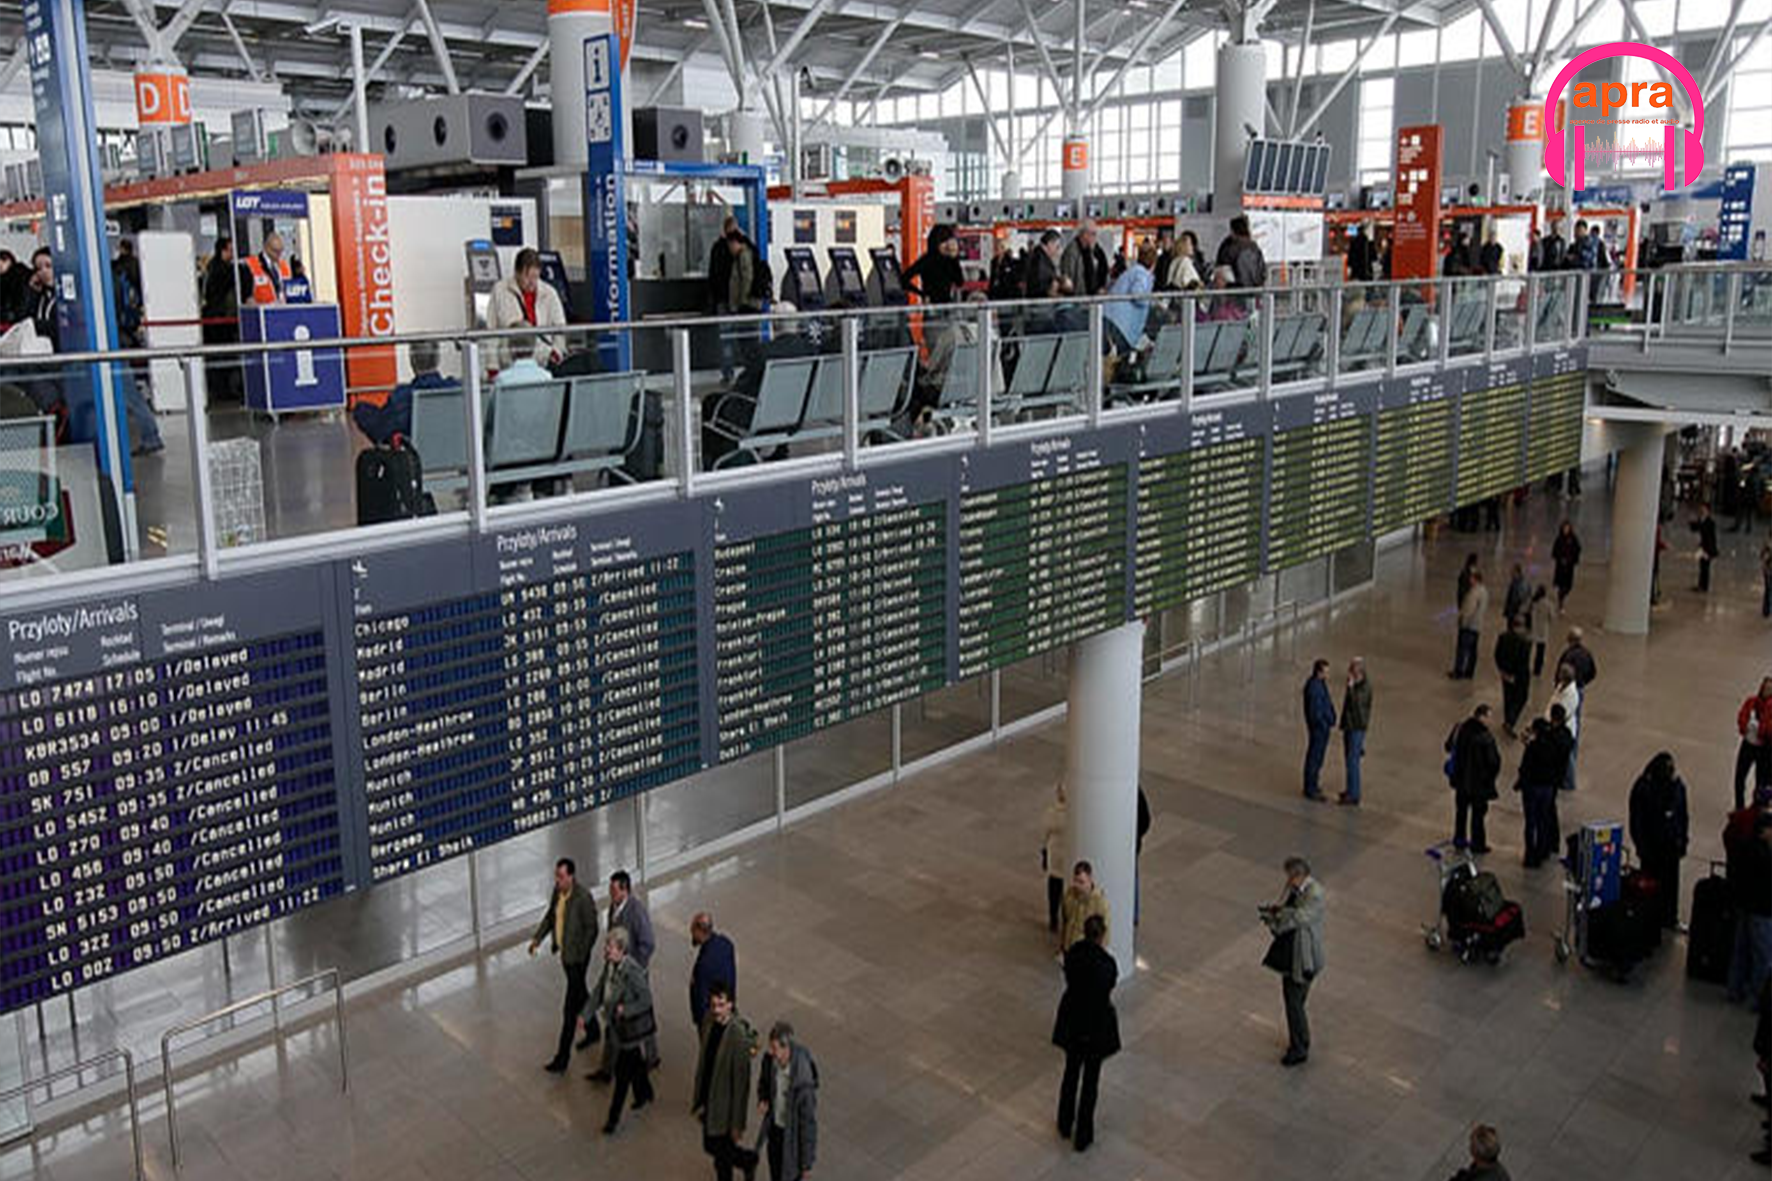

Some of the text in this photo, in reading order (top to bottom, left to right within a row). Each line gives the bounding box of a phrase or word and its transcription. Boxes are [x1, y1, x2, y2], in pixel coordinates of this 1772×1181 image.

[140, 82, 160, 115] D
[1524, 110, 1539, 135] E
[363, 175, 393, 336] Check-in
[9, 601, 138, 642] Przyloty/Arrivals
[20, 690, 40, 708] LO
[22, 717, 44, 735] LO
[34, 820, 56, 839] LO
[37, 846, 58, 864] LO
[40, 872, 60, 890] LO
[43, 897, 64, 915] LO
[48, 946, 69, 965] LO
[52, 971, 72, 990] LO
